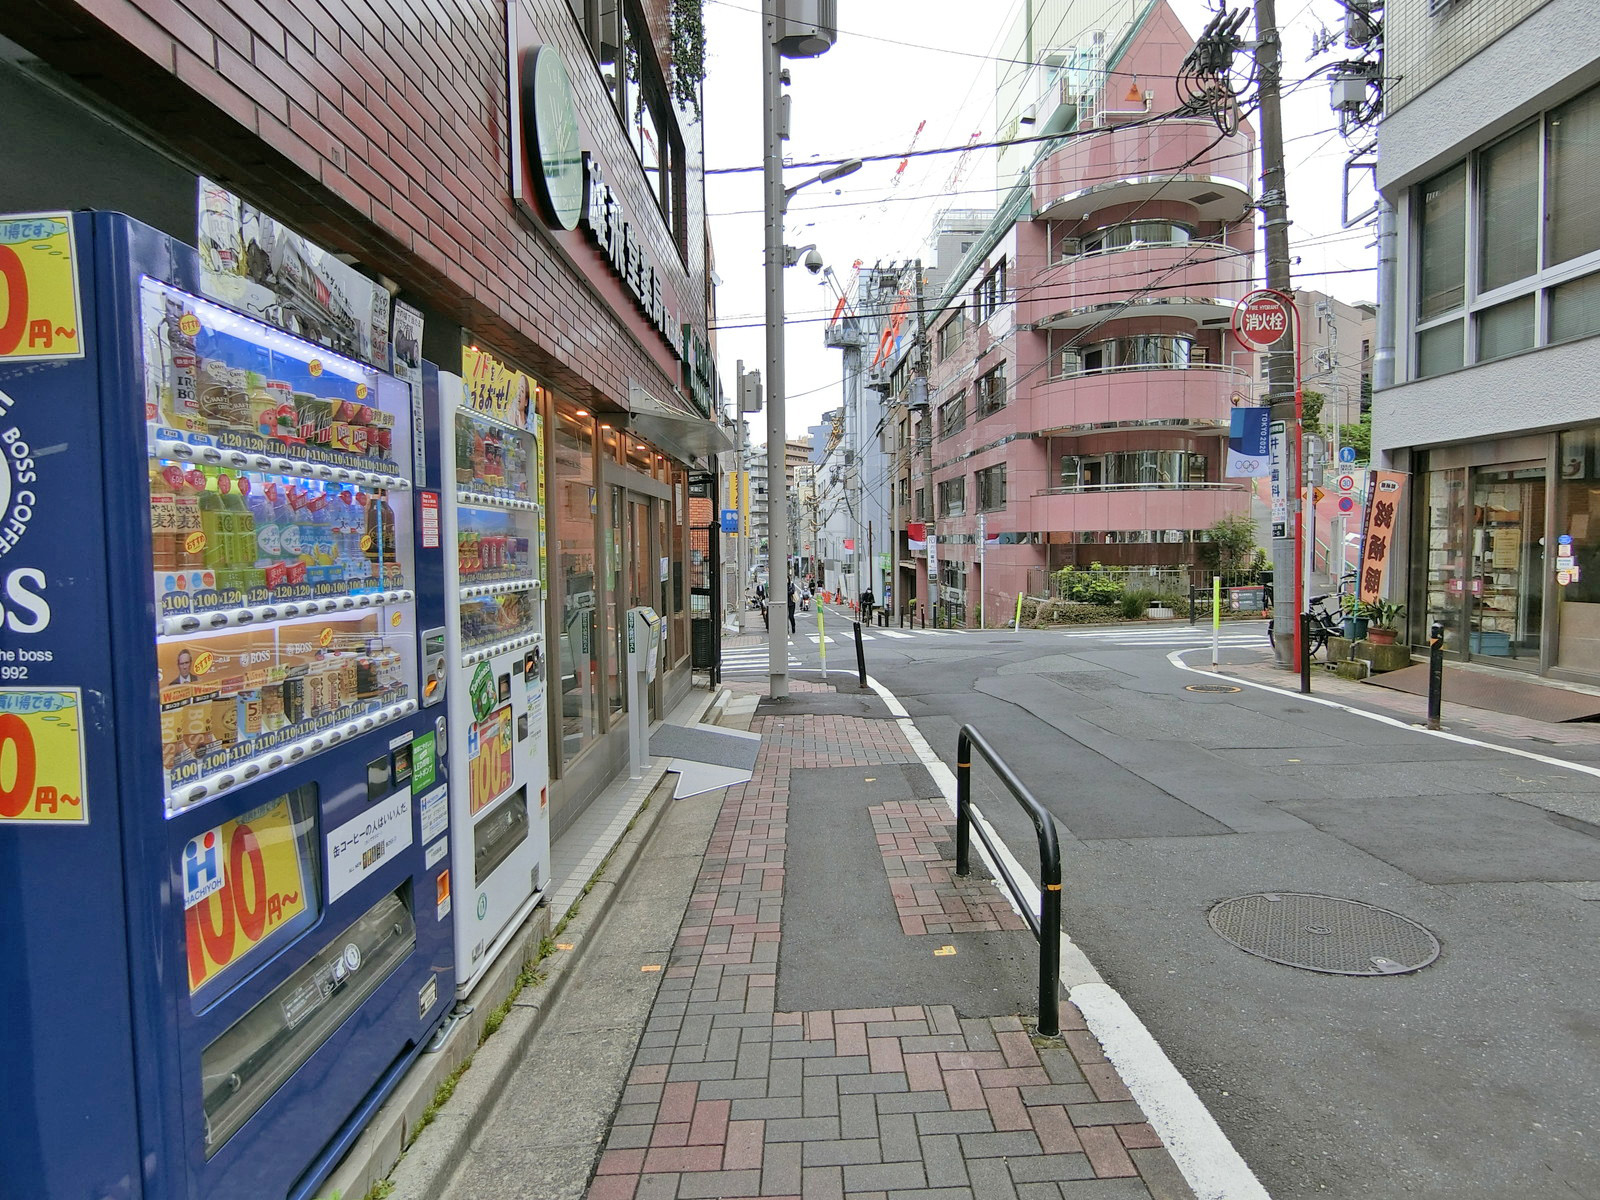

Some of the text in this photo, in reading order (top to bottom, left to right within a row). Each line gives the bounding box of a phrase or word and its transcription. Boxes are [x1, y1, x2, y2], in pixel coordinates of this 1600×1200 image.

[1246, 312, 1283, 331] 消火栓
[1260, 413, 1268, 436] TOKYO
[220, 433, 242, 447] ¥120
[243, 438, 263, 451] ¥120
[266, 442, 287, 454] ¥110
[289, 446, 307, 458] ¥110
[2, 427, 36, 484] BOSS
[152, 513, 176, 529] 麦茶
[177, 514, 201, 529] 麦茶
[186, 536, 204, 550] おすすめ
[219, 591, 242, 604] ¥120
[249, 589, 268, 601] ¥120
[274, 586, 292, 598] ¥120
[293, 585, 311, 596] ¥120
[162, 595, 189, 610] ¥100
[193, 594, 218, 607] ¥100
[18, 648, 53, 662] boss
[295, 642, 312, 654] BOSS
[195, 652, 212, 672] おすすめ
[250, 650, 270, 664] BOSS
[254, 734, 275, 750] ¥110
[229, 743, 252, 759] ¥110
[202, 752, 226, 770] ¥100
[171, 763, 197, 781] ¥100
[184, 878, 222, 906] HACHIYOH
